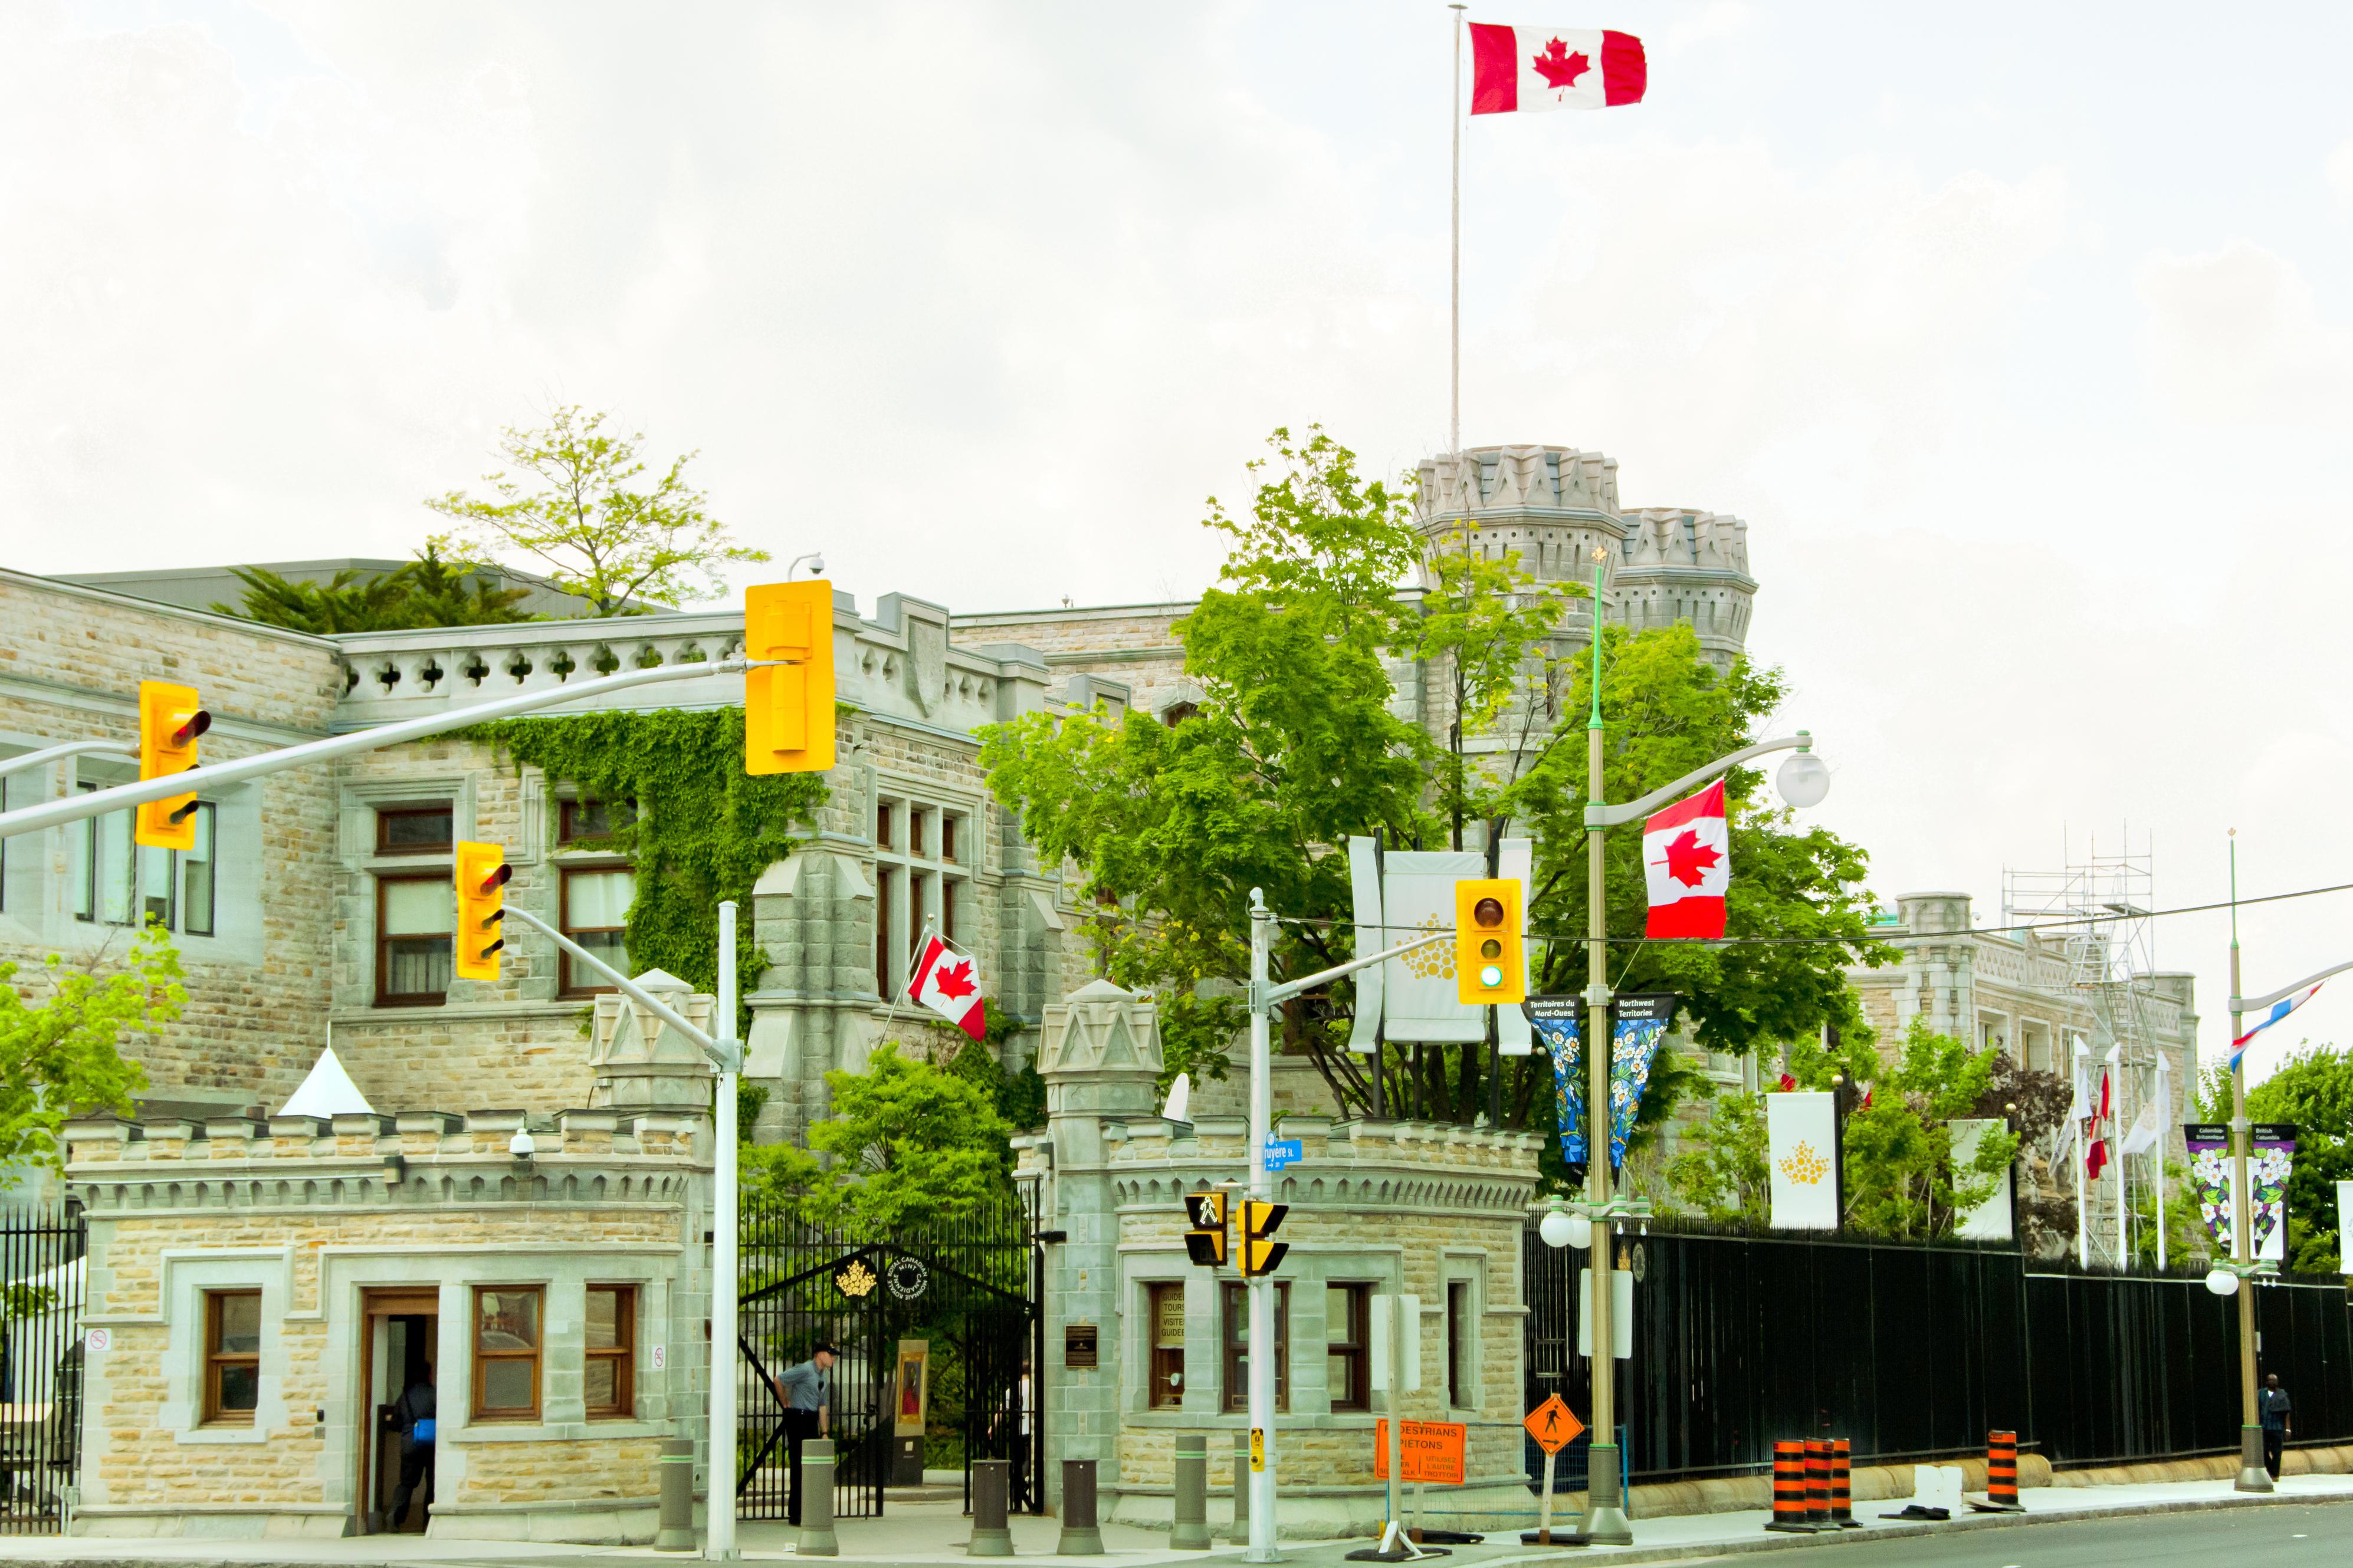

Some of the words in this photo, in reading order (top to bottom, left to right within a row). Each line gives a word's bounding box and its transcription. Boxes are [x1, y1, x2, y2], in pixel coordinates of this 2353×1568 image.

[1535, 1009, 1574, 1017] Nord-Ouest
[1265, 1143, 1287, 1162] ruyère
[887, 1260, 901, 1277] ROYAL
[901, 1257, 928, 1277] CANADIAN
[887, 1280, 904, 1299] ROYALE
[894, 1274, 921, 1293] CANADIENNE
[904, 1280, 928, 1300] MONNAIE
[1384, 1425, 1457, 1437] PDESTRIANS
